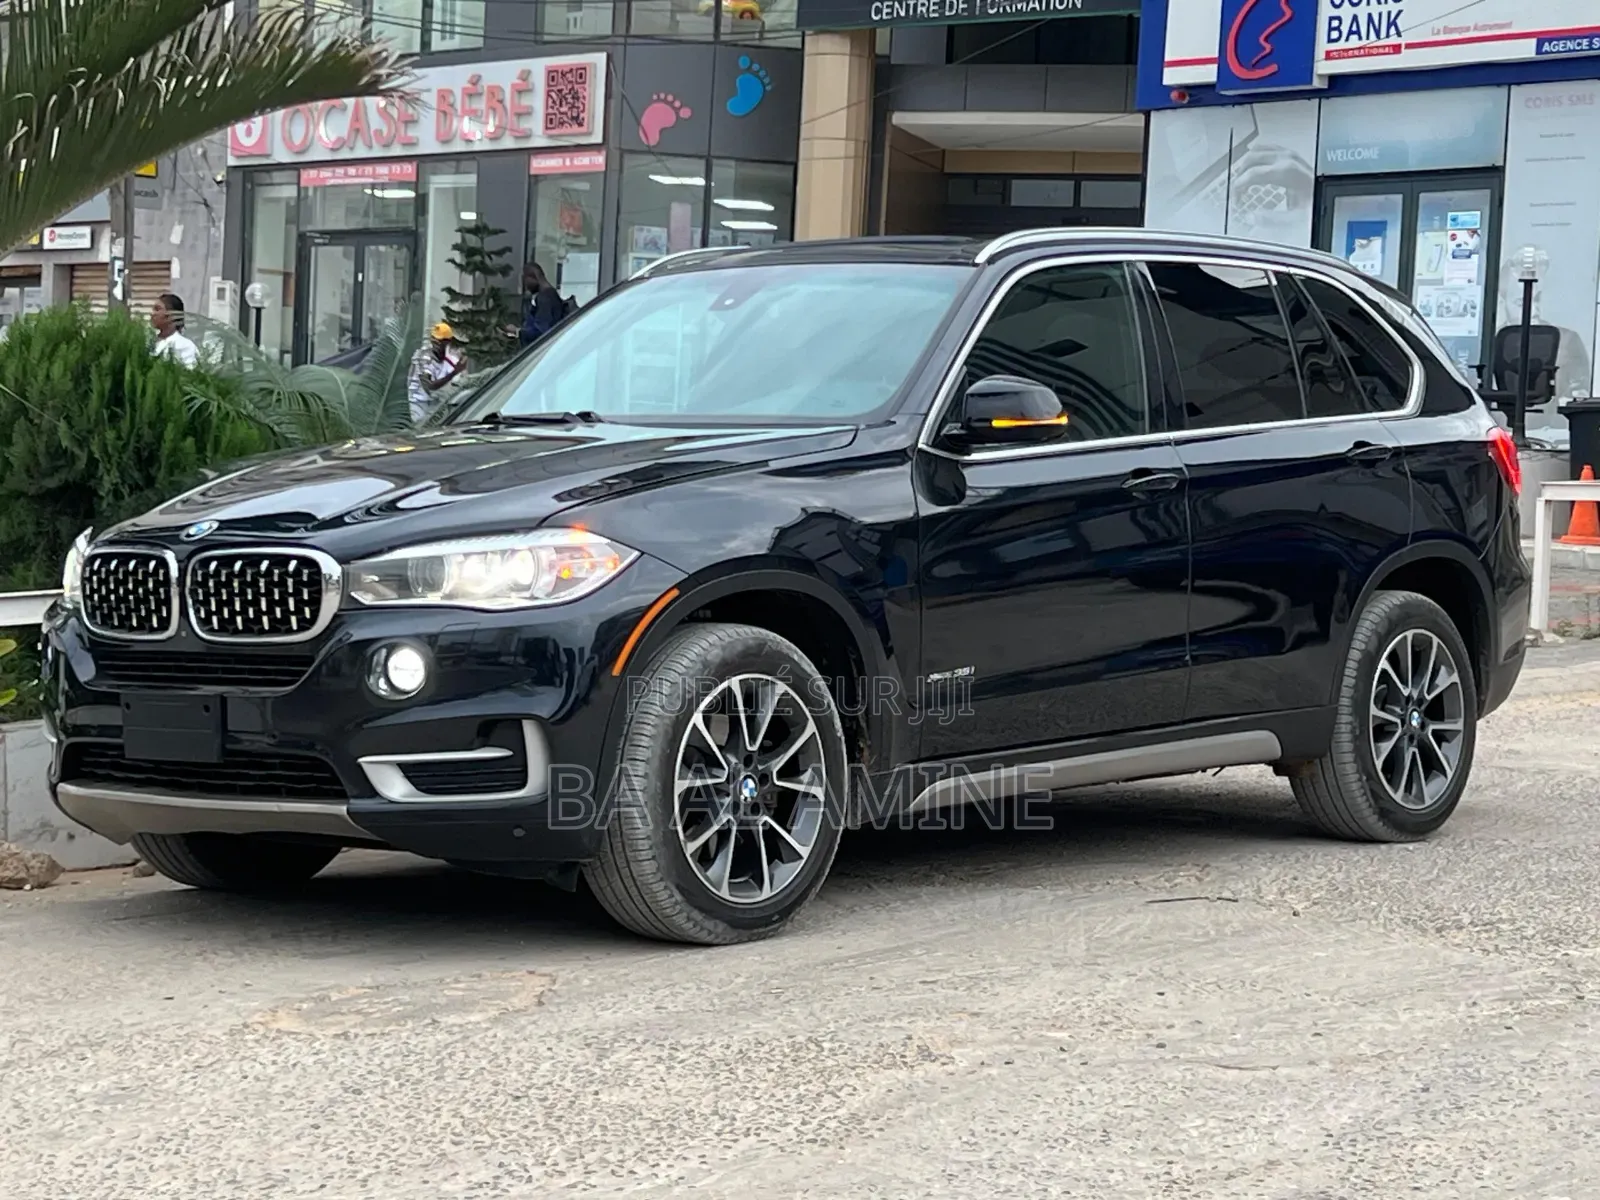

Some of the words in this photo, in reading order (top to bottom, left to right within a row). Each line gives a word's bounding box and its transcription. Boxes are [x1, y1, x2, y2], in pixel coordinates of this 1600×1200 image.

[870, 1, 940, 21] CENTRE
[945, 0, 969, 16] DE
[1326, 9, 1404, 44] BANK
[1541, 39, 1590, 52] AGENCE
[281, 95, 418, 154] OCASE
[436, 69, 534, 143] BÉBÉ
[1326, 147, 1379, 162] WELCOME
